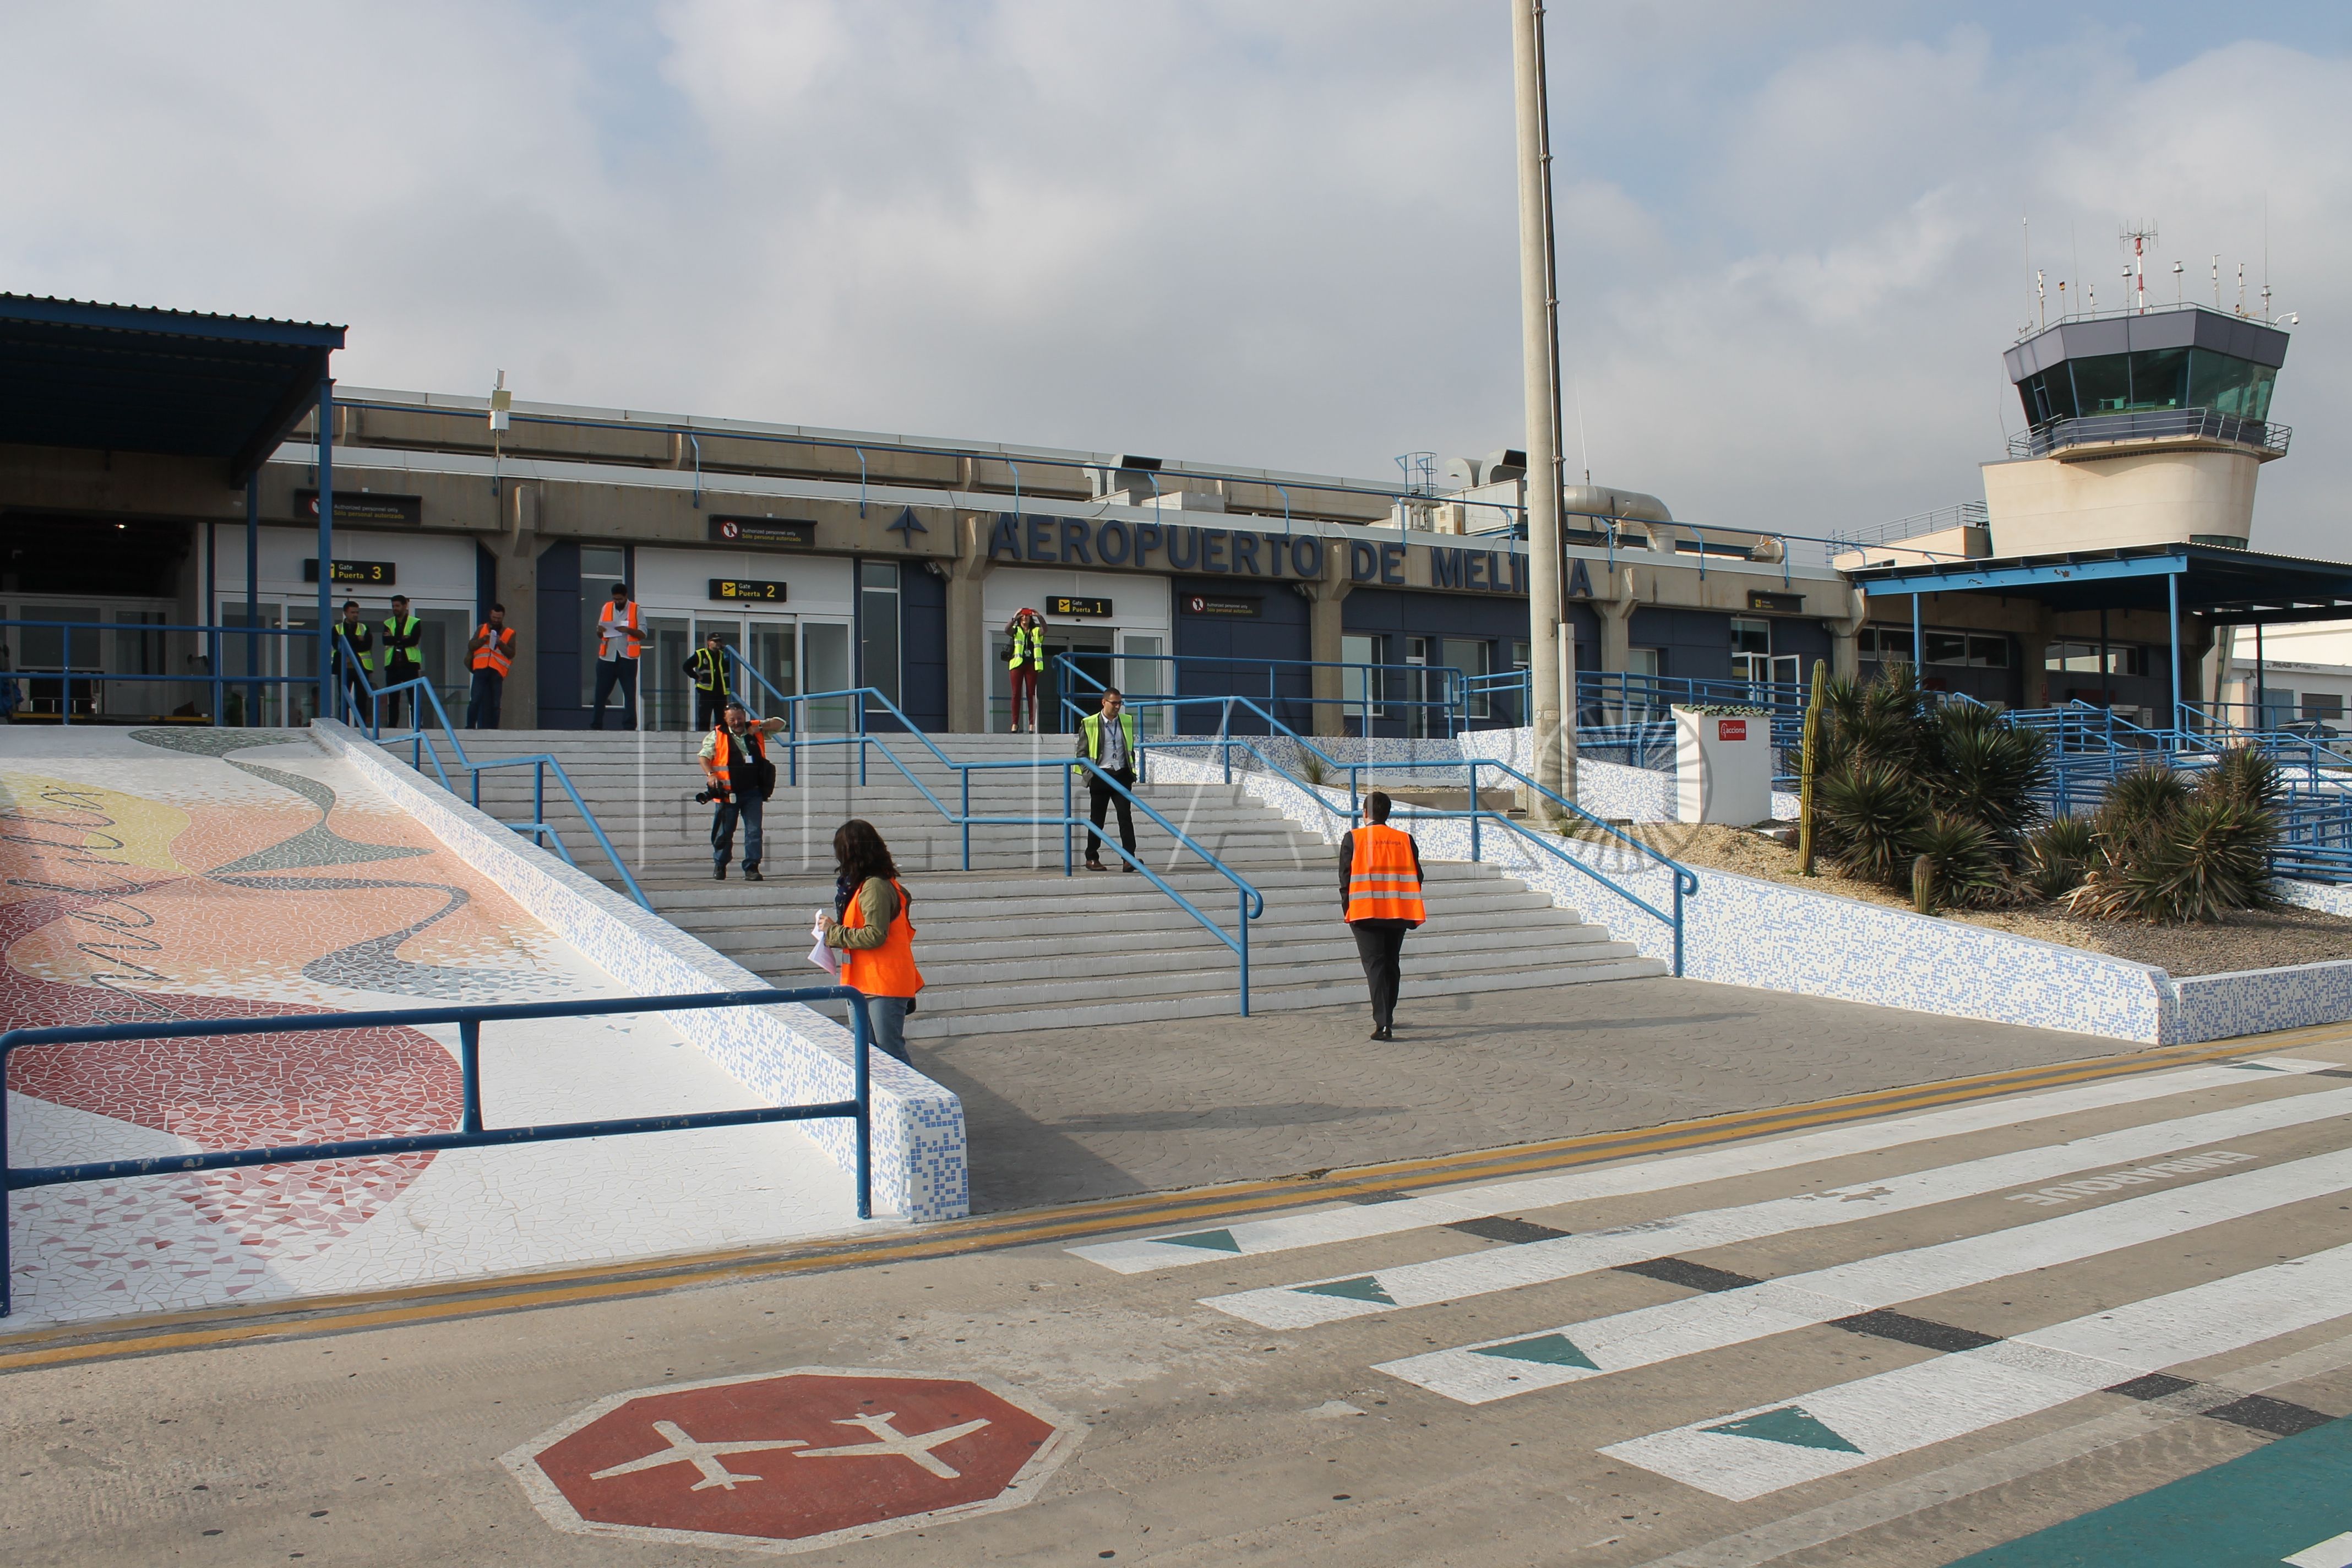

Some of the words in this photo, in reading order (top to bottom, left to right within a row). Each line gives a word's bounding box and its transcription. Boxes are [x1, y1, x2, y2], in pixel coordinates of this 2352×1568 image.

[989, 512, 1322, 578] AEROPUERTO
[1351, 540, 1406, 584] DE
[1431, 546, 1594, 597] MELIA
[372, 566, 382, 580] 3
[767, 585, 775, 598] 2
[1096, 602, 1102, 613] 1
[2005, 1150, 2259, 1206] EMBARQUE
